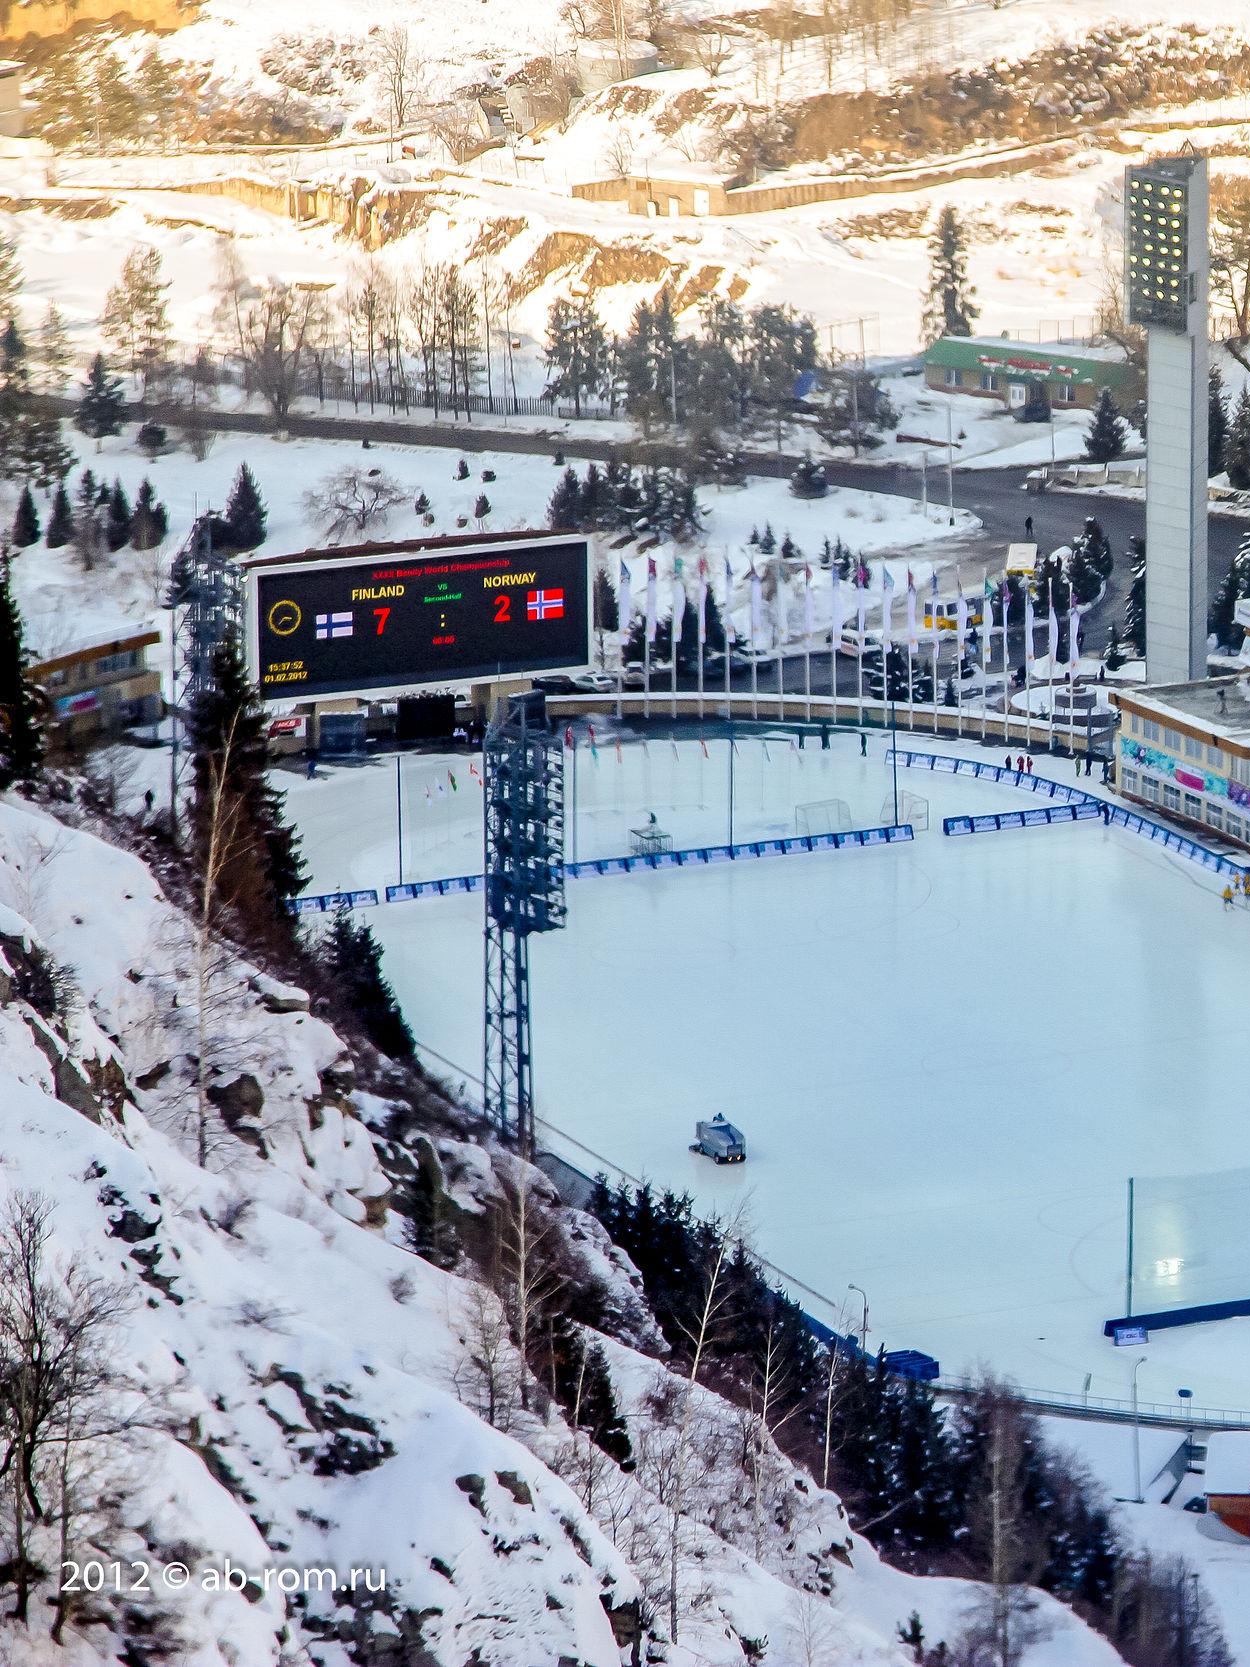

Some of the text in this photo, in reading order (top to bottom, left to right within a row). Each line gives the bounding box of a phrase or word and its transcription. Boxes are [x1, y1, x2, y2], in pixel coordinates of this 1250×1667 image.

[396, 567, 422, 578] Bandy
[424, 563, 449, 574] World
[451, 559, 510, 572] Championship
[351, 584, 405, 602] FINLAND
[483, 572, 537, 589] NORWAY
[373, 607, 391, 635] 7
[493, 595, 511, 622] 2
[264, 671, 308, 683] 01.02.2012
